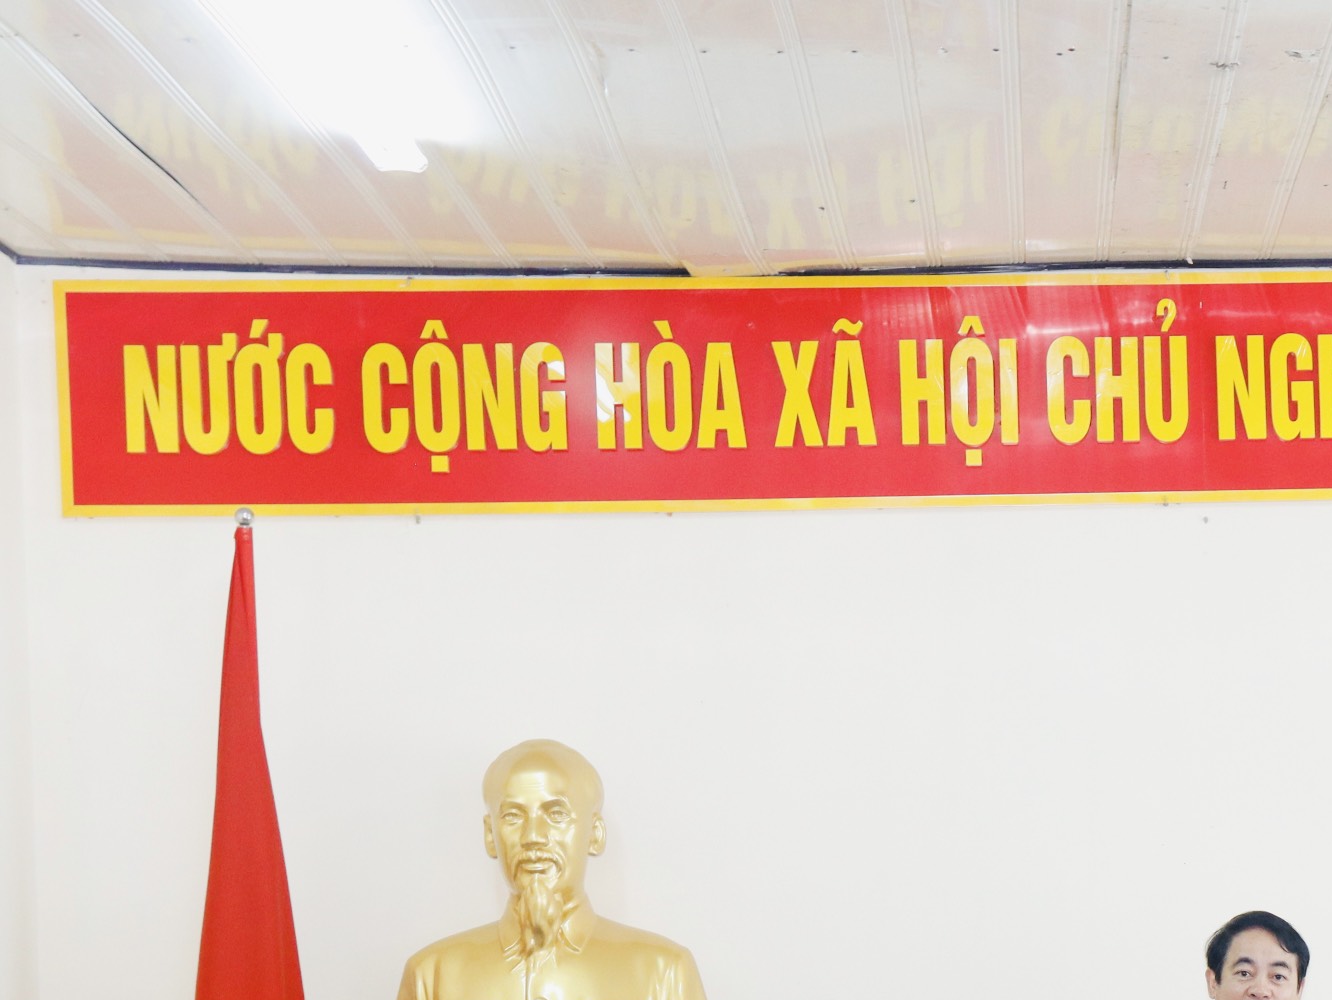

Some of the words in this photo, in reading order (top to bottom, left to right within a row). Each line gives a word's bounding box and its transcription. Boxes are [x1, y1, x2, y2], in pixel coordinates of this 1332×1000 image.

[123, 318, 335, 455] NƯỚC
[361, 319, 568, 473] CỘNG
[594, 320, 748, 450] HÒA
[771, 317, 878, 448] XÃ
[898, 314, 1020, 467] HỘI
[1046, 299, 1190, 445] CHỦ
